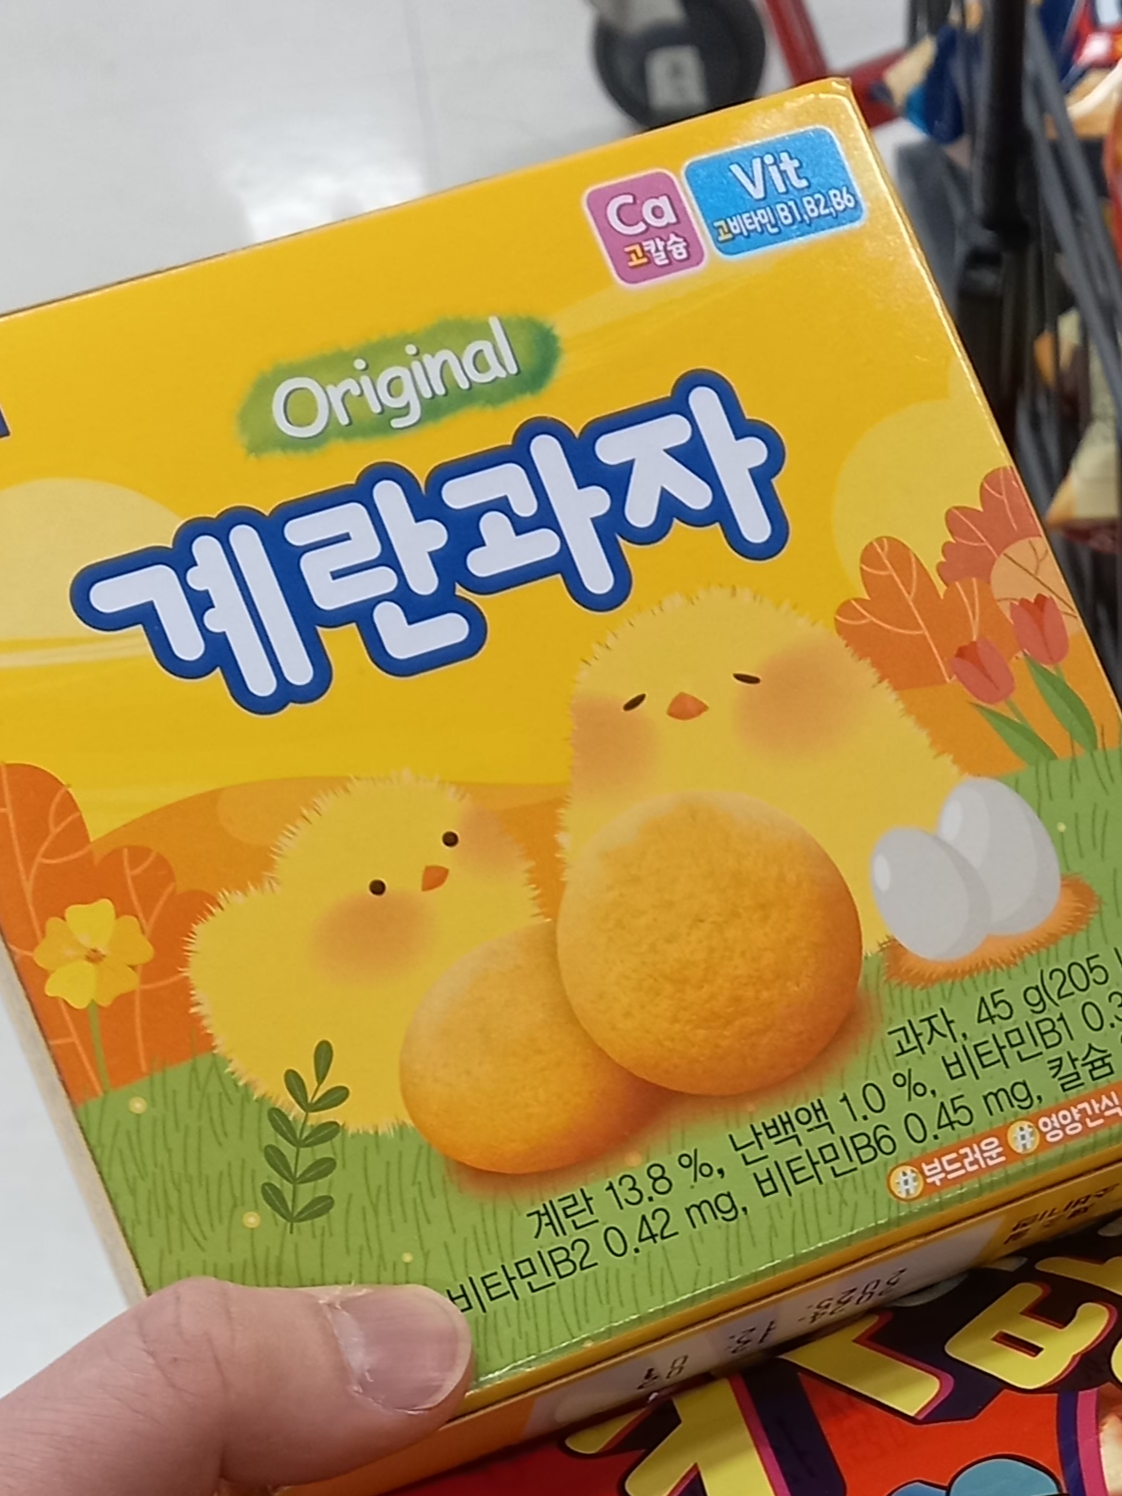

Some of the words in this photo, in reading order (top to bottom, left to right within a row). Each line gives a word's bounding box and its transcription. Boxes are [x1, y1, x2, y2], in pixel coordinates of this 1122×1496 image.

[606, 194, 678, 235] Ca
[713, 210, 780, 242] 고비타민
[779, 185, 857, 226] B1,B2,B6
[729, 150, 810, 200] Vit
[624, 232, 690, 268] 고칼슘
[271, 316, 519, 437] Original
[78, 376, 783, 706] 계란과자
[887, 1008, 968, 1058] 과자,
[976, 989, 1014, 1029] 45
[1023, 954, 1109, 1015] g(205
[446, 1236, 599, 1313] 비타민B2
[603, 1207, 680, 1258] 0.42
[684, 1191, 749, 1230] mg,
[752, 1123, 898, 1198] 비타민B6
[903, 1093, 974, 1146] 0.45
[982, 1078, 1043, 1117] mg,
[1047, 1043, 1116, 1094] 칼슘
[526, 1187, 599, 1240] 계란
[604, 1162, 673, 1211] 13.8
[678, 1148, 726, 1183] %,
[728, 1098, 836, 1167] 난백액
[838, 1082, 887, 1123] 1.0
[893, 1068, 937, 1101] %,
[941, 1012, 1075, 1081] 비타민B1
